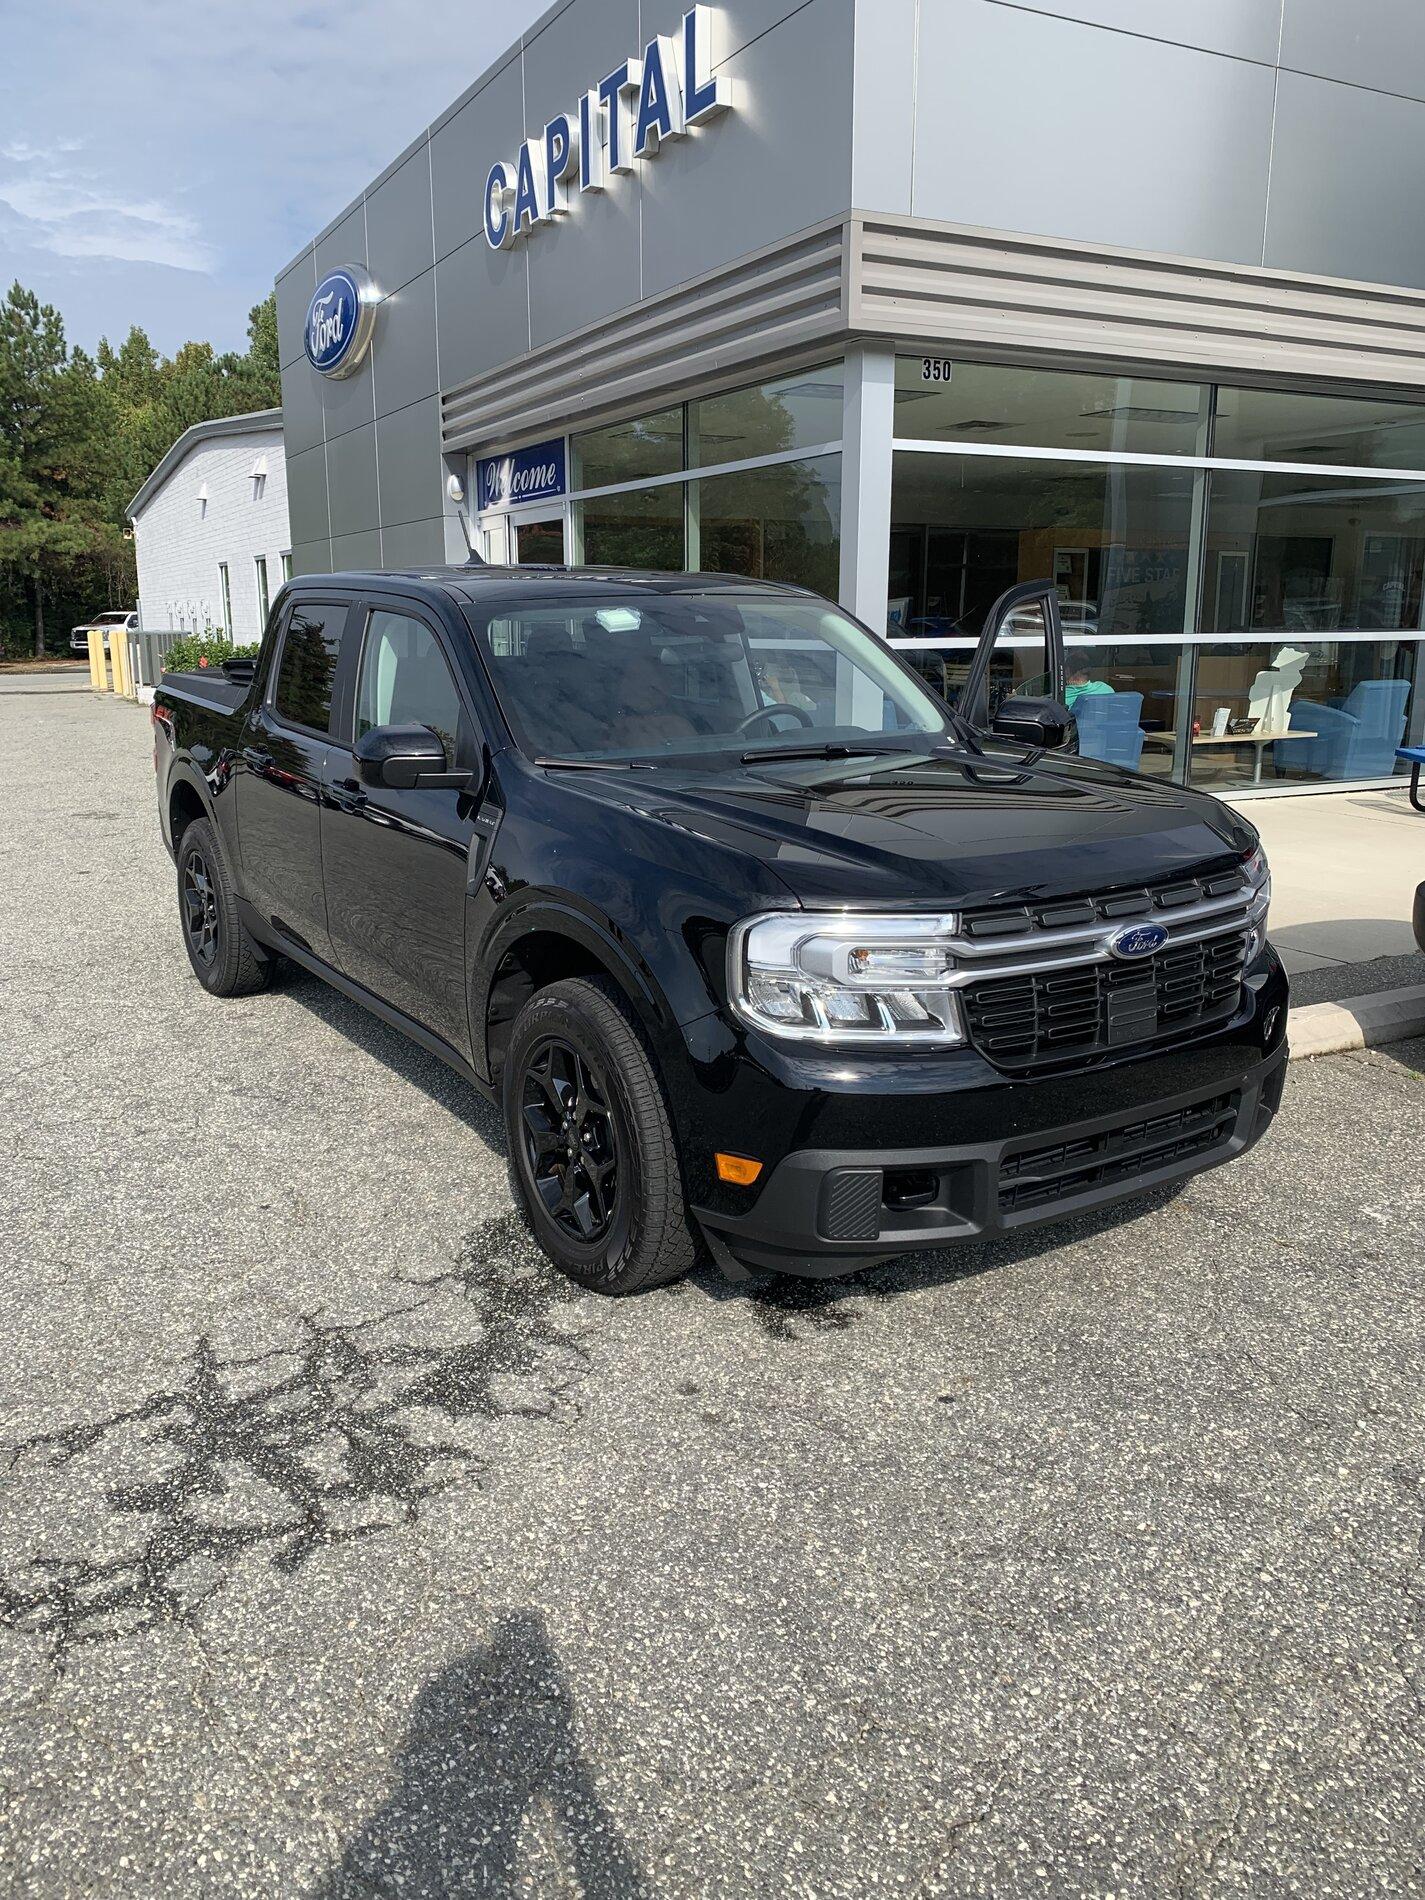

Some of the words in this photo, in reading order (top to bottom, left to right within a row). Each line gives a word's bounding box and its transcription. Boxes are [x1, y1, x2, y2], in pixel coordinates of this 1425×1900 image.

[483, 4, 732, 249] CAPITAL
[312, 291, 343, 357] Ford
[922, 358, 951, 382] 350
[486, 458, 556, 498] Welcome
[1129, 930, 1157, 952] Ford
